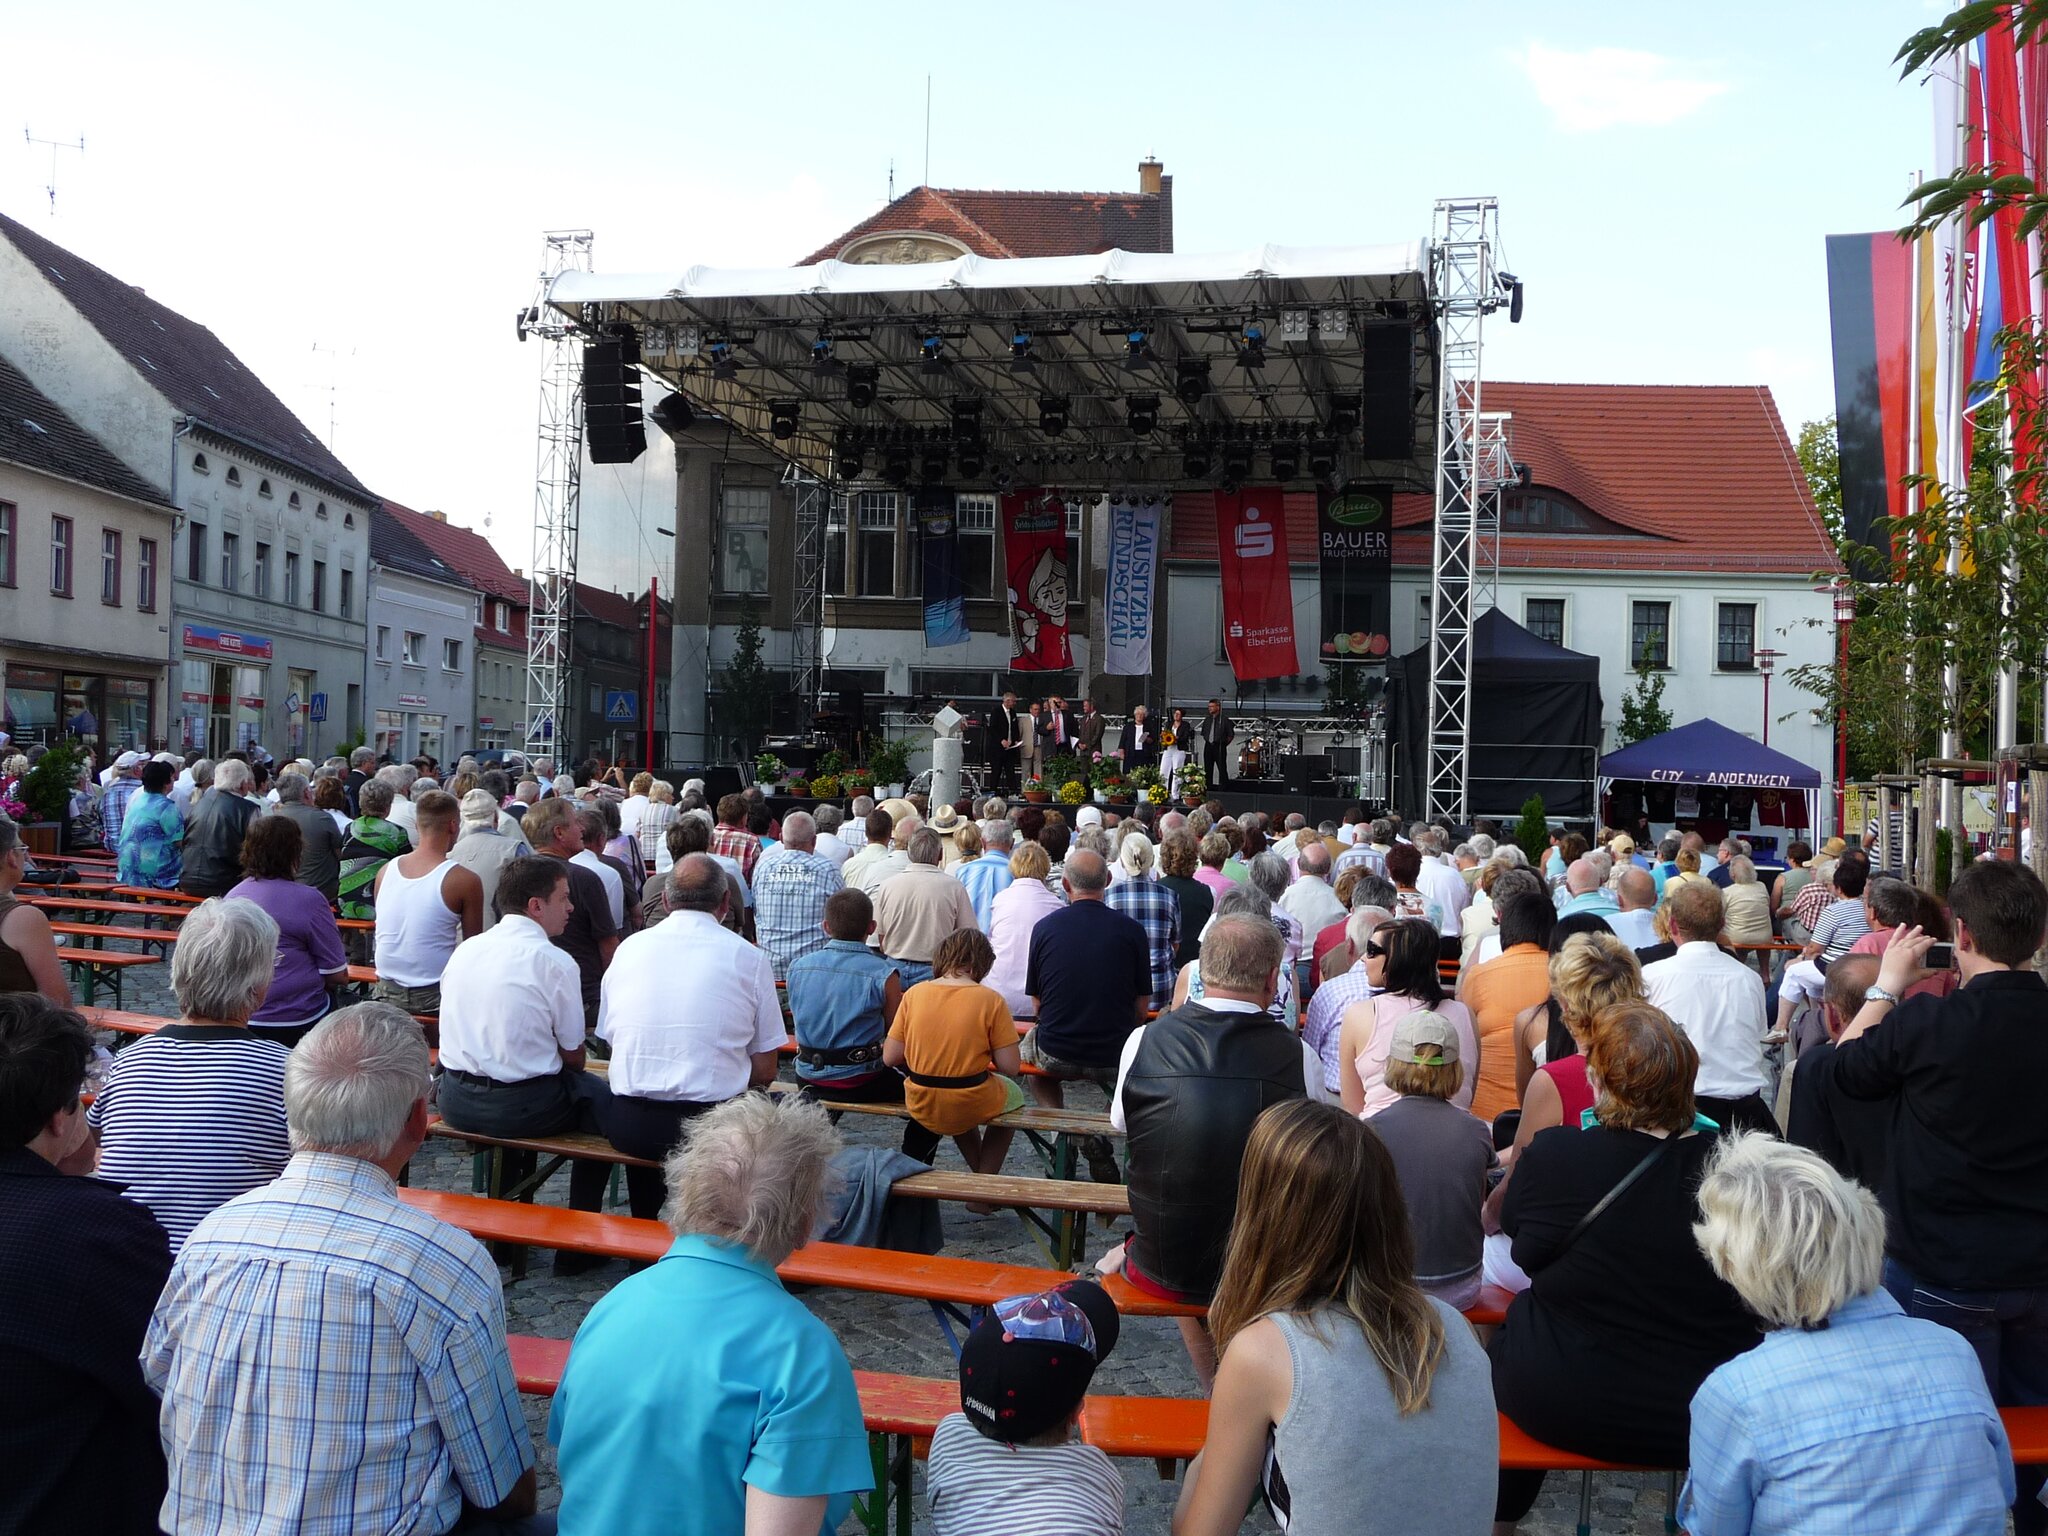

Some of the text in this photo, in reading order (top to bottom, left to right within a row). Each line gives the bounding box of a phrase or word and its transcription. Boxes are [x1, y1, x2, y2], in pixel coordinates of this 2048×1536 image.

[1323, 531, 1388, 548] BAUER
[728, 532, 767, 592] BAR
[1323, 549, 1389, 558] FRUCHTSÄFTE
[1110, 510, 1134, 649] RUNDSCHAU
[1130, 519, 1154, 640] LAUSITZER
[1246, 626, 1289, 638] Sparkasse
[1247, 636, 1292, 647] Elbe-Elster
[1651, 769, 1684, 782] CITY
[1706, 771, 1790, 787] ANDENKEN
